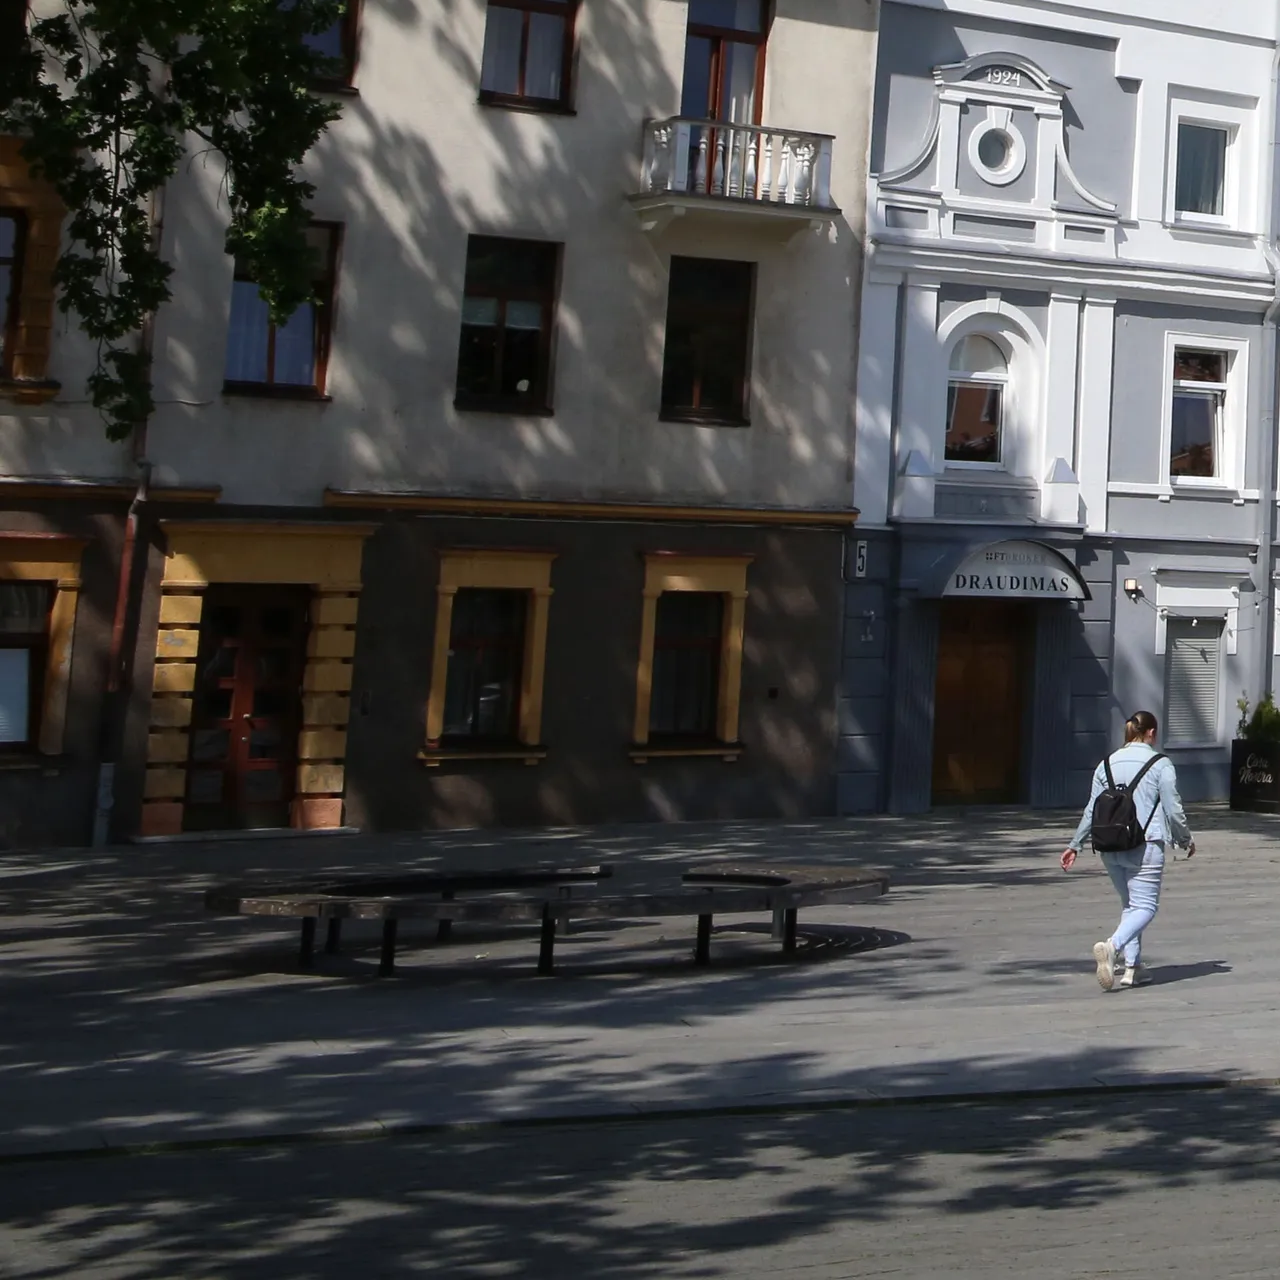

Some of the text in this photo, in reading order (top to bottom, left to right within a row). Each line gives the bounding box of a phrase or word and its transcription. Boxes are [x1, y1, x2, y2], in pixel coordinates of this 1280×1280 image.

[985, 68, 1020, 87] 1924
[858, 545, 865, 573] 5
[955, 574, 1069, 592] DRAUDIMAS
